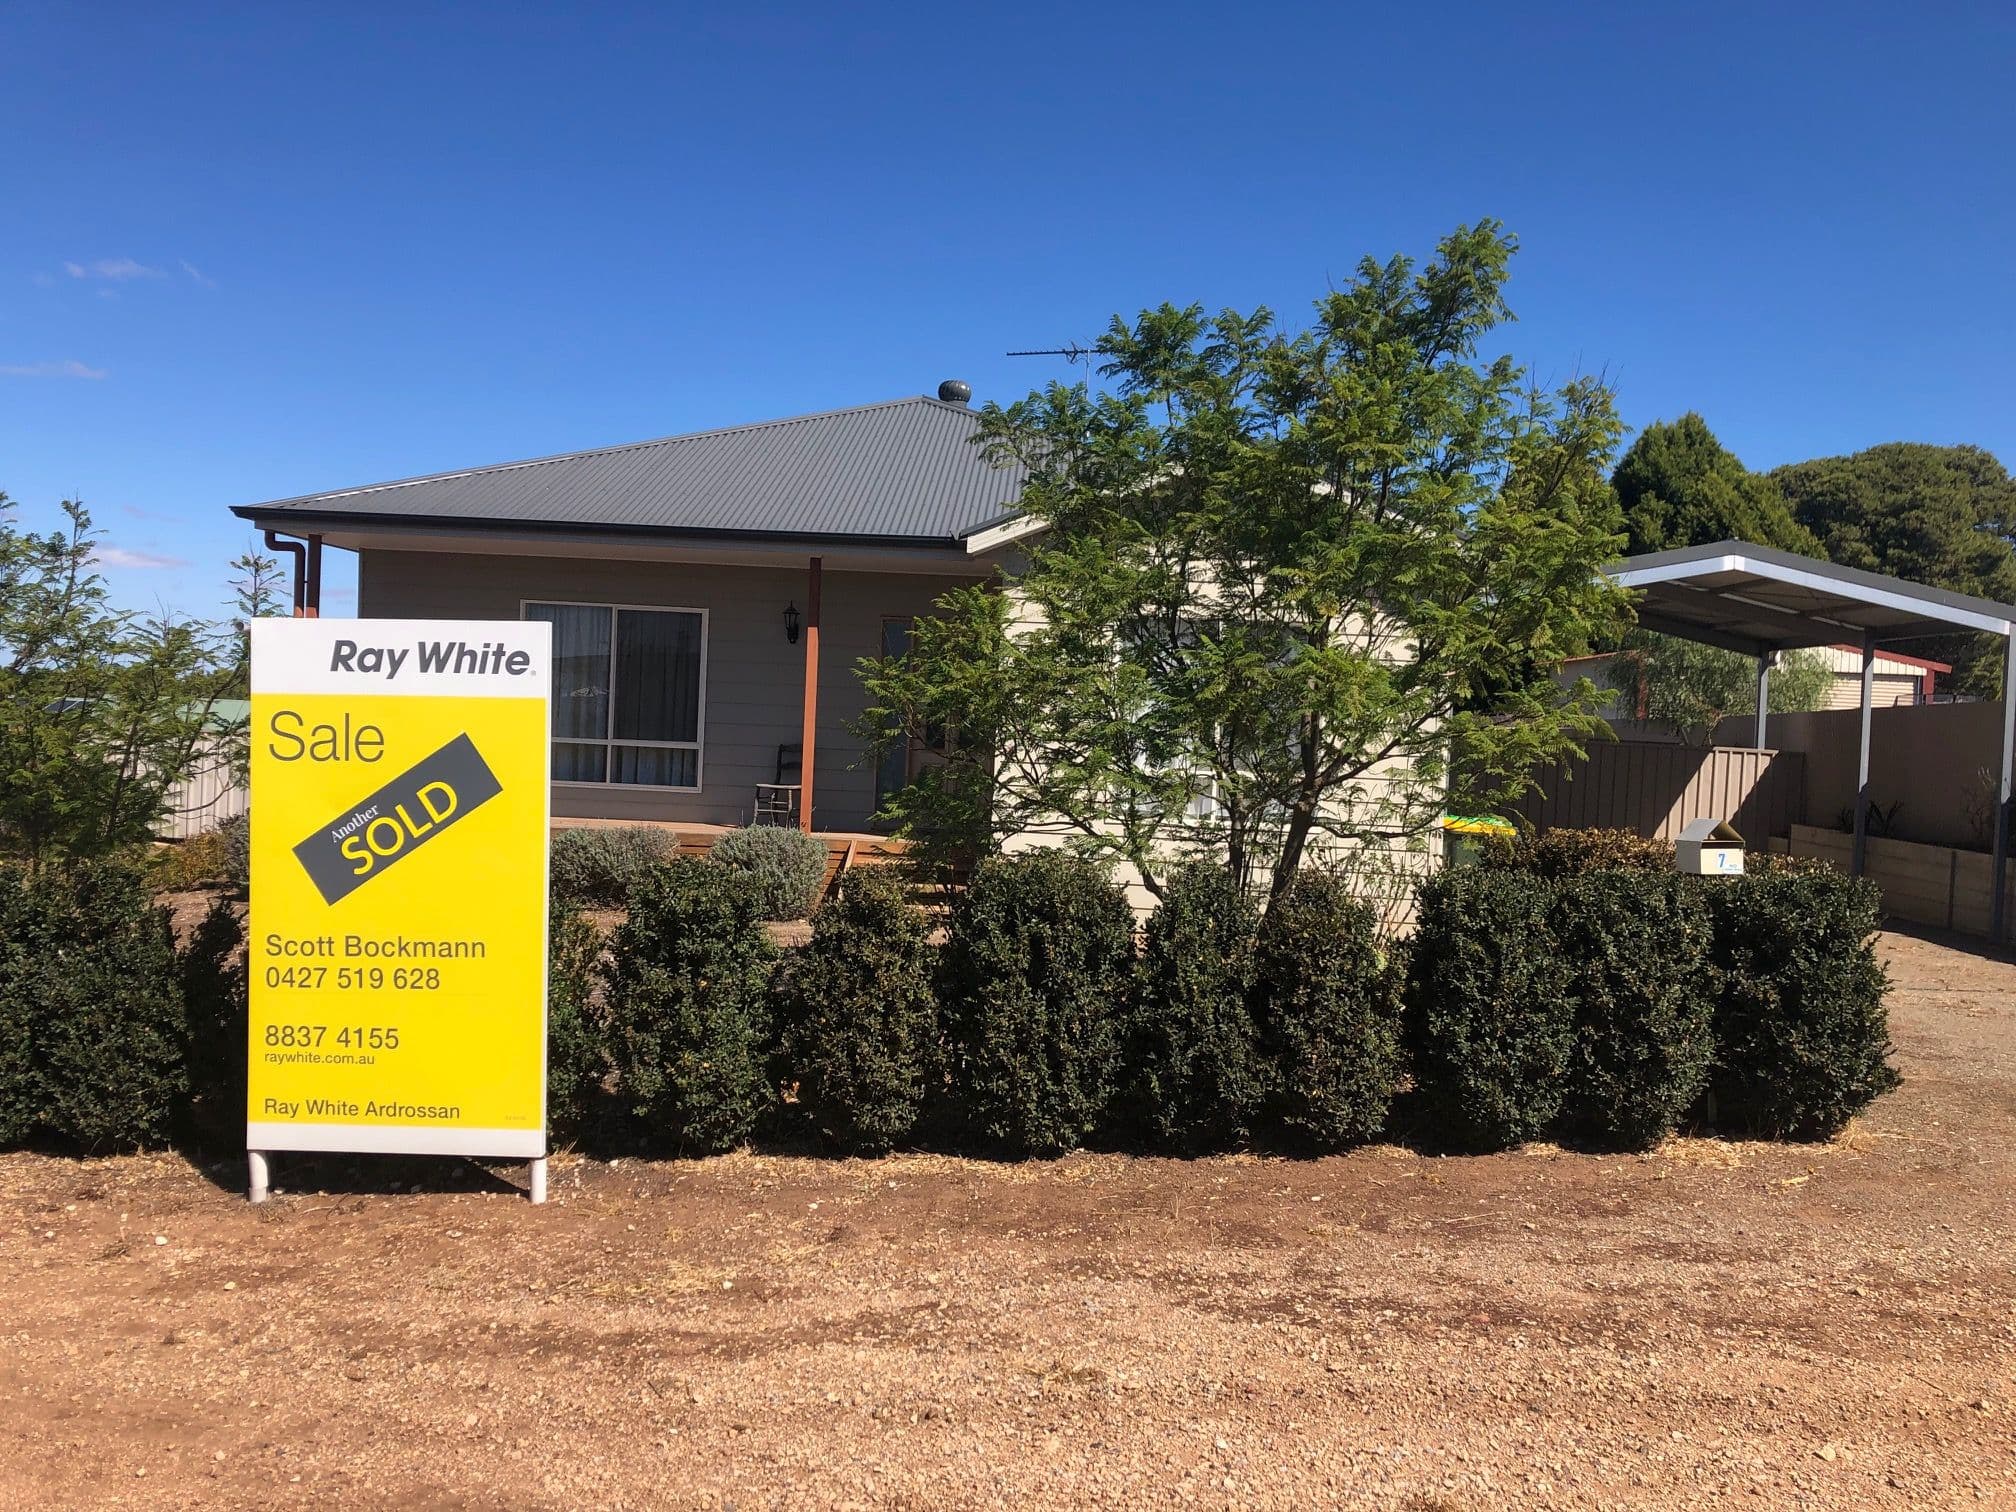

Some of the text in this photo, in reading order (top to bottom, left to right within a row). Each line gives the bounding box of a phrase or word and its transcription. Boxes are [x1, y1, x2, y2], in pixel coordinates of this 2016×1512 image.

[330, 639, 530, 680] Ray White
[268, 710, 385, 762] Sale
[331, 804, 380, 843] Another
[341, 781, 459, 876] SOLD
[1718, 853, 1726, 868] 7
[265, 934, 486, 958] Scott Bockmann
[265, 966, 440, 990] 0427 519 628
[265, 1025, 400, 1049] 8837 4155
[264, 1051, 375, 1065] raywhite.com.au
[264, 1098, 460, 1119] Ray White Ardrossan
